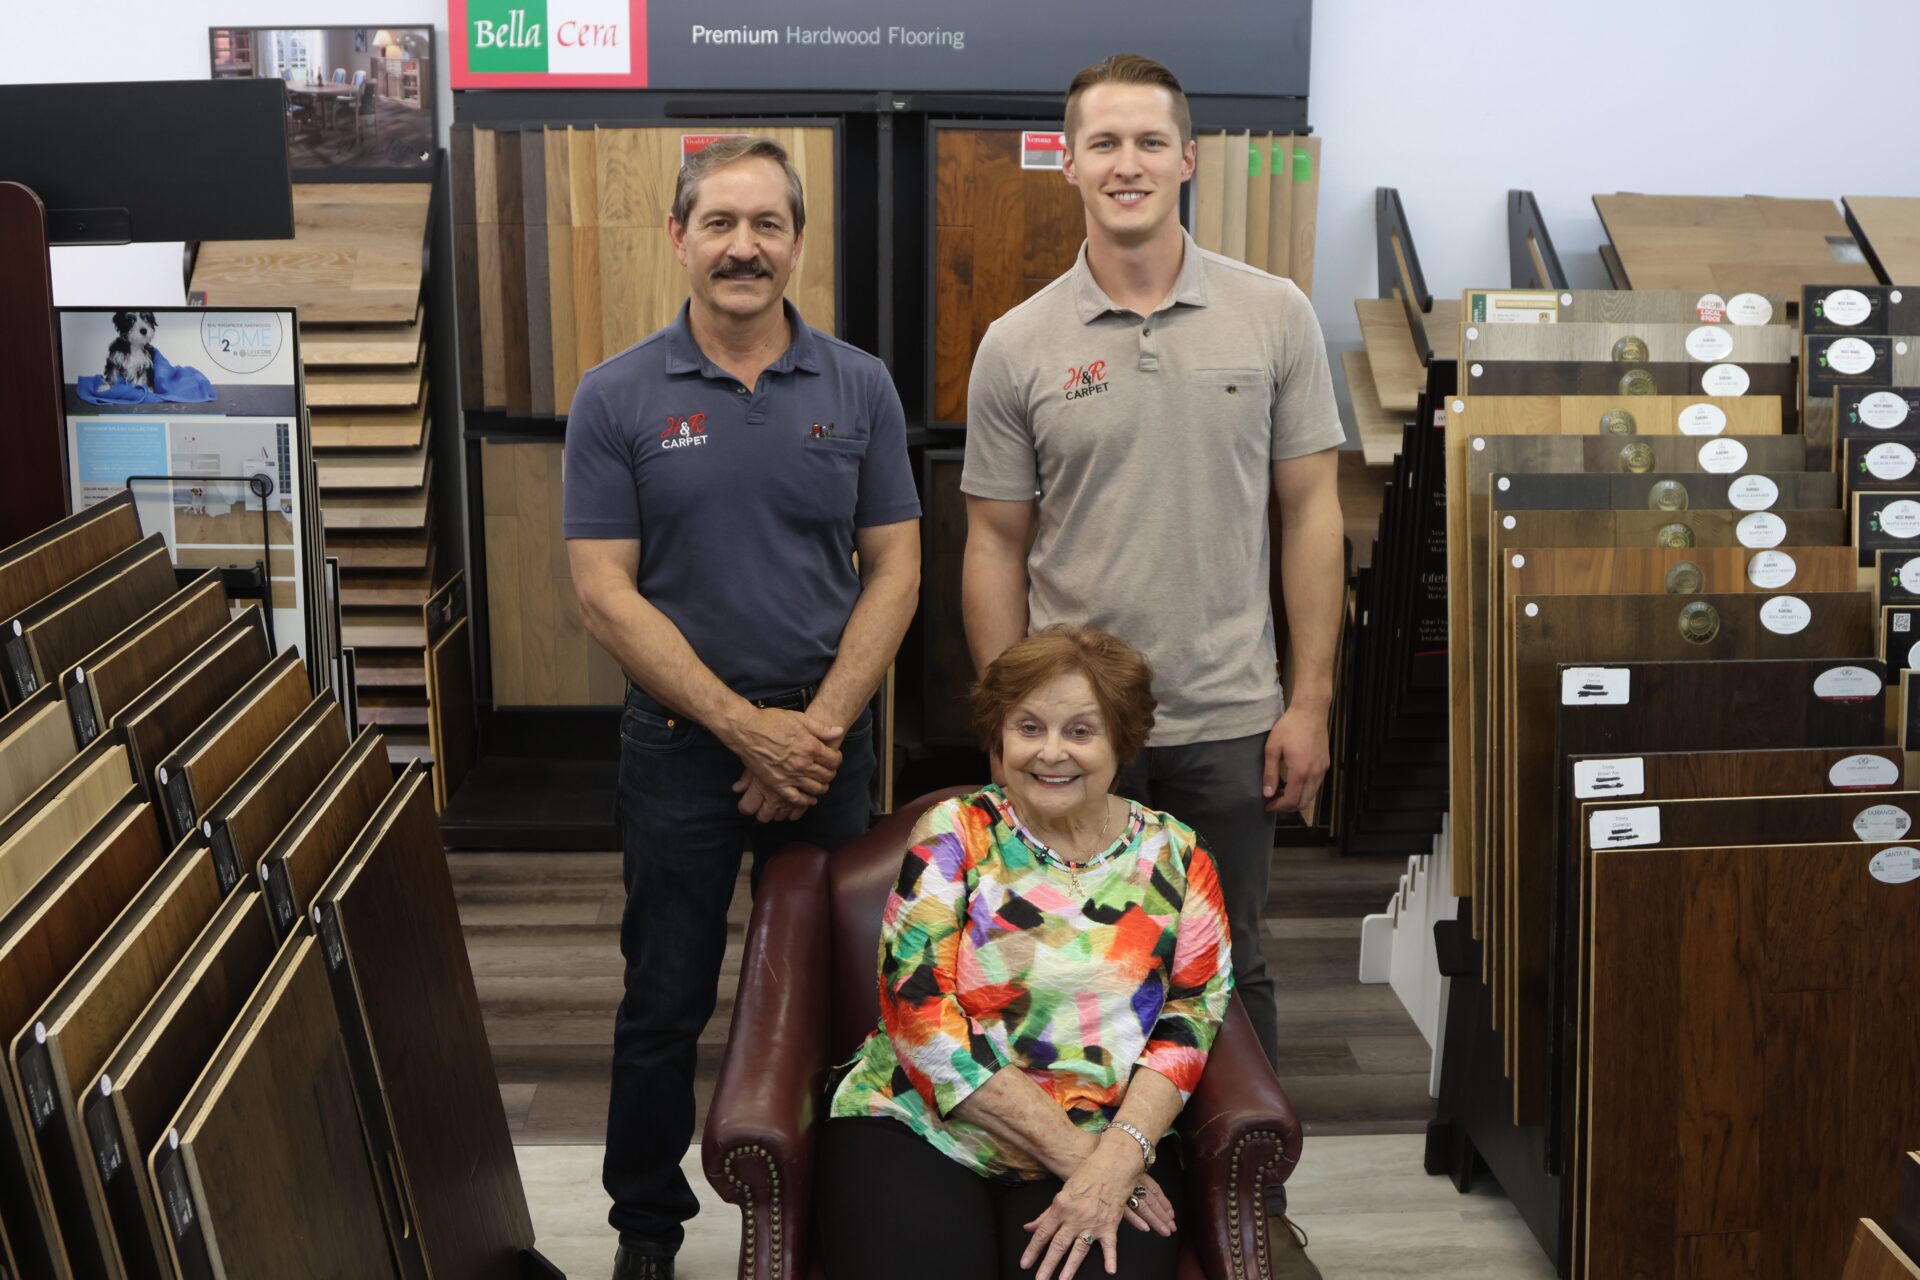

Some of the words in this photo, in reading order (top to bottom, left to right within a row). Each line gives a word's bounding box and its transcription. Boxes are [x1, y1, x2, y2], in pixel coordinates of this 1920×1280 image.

[473, 9, 542, 48] Bella
[556, 20, 619, 47] Cera
[692, 25, 778, 44] Premium
[786, 26, 880, 45] Hardwood
[888, 26, 965, 49] Flooring
[1701, 308, 1721, 316] LOCAL
[1701, 314, 1721, 322] STOCK
[207, 327, 272, 348] HOME
[221, 339, 231, 352] 2
[1063, 359, 1107, 390] H&R
[1065, 382, 1110, 401] CARPET
[660, 413, 707, 438] H&R
[661, 434, 708, 449] CARPET
[1867, 809, 1897, 817] DURANGO
